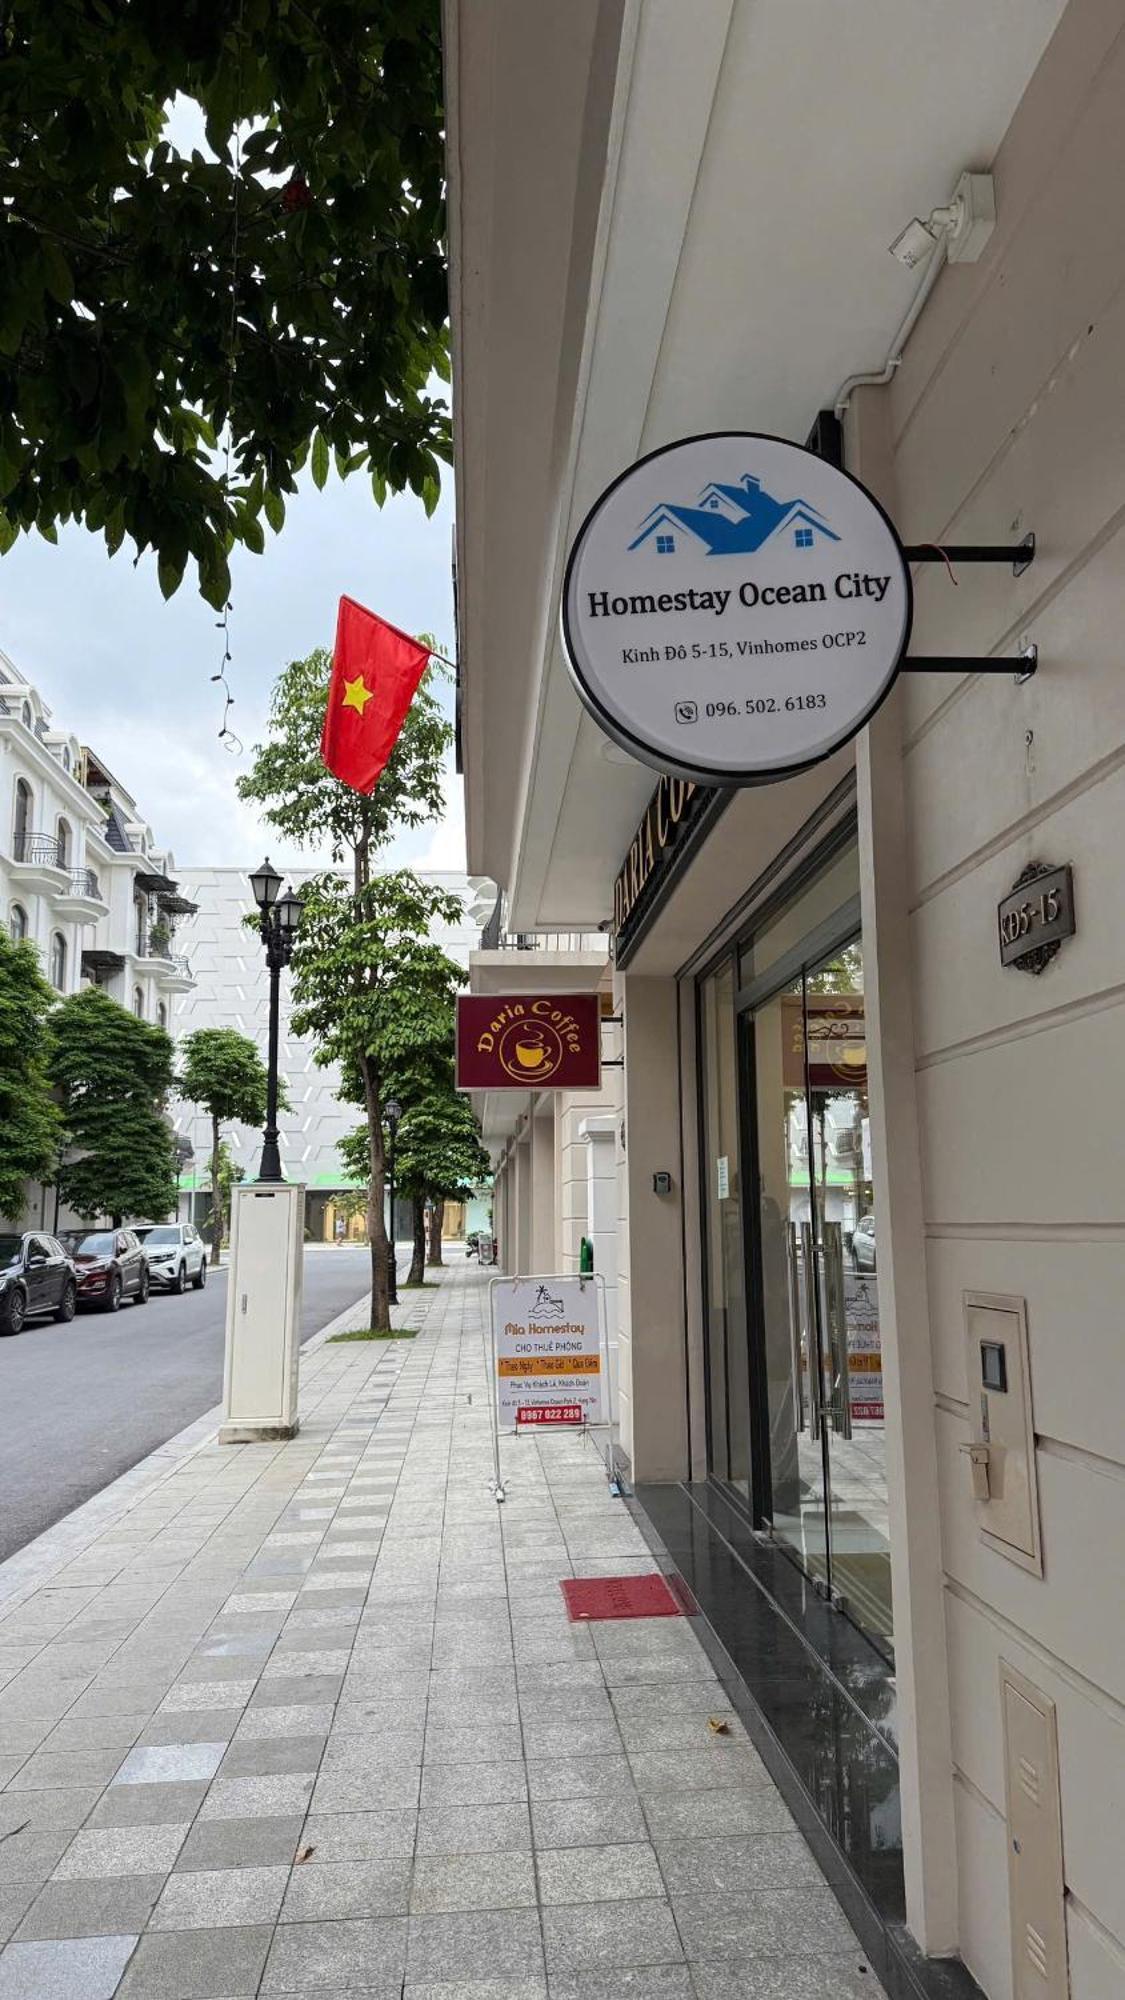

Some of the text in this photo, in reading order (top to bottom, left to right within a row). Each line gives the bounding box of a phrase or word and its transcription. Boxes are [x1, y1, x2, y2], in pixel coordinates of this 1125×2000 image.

[587, 573, 892, 617] Homestay Ocean City
[622, 631, 867, 664] Kinh Đô 5-15, Vinhomes OCP2
[706, 694, 826, 717] 096. 502. 6183
[614, 808, 655, 938] DARIA
[476, 1000, 582, 1053] Daria Coffee
[504, 1322, 585, 1336] Mia Homestay
[515, 1343, 532, 1352] CHO
[544, 1409, 562, 1419] 022
[563, 1408, 580, 1419] 289
